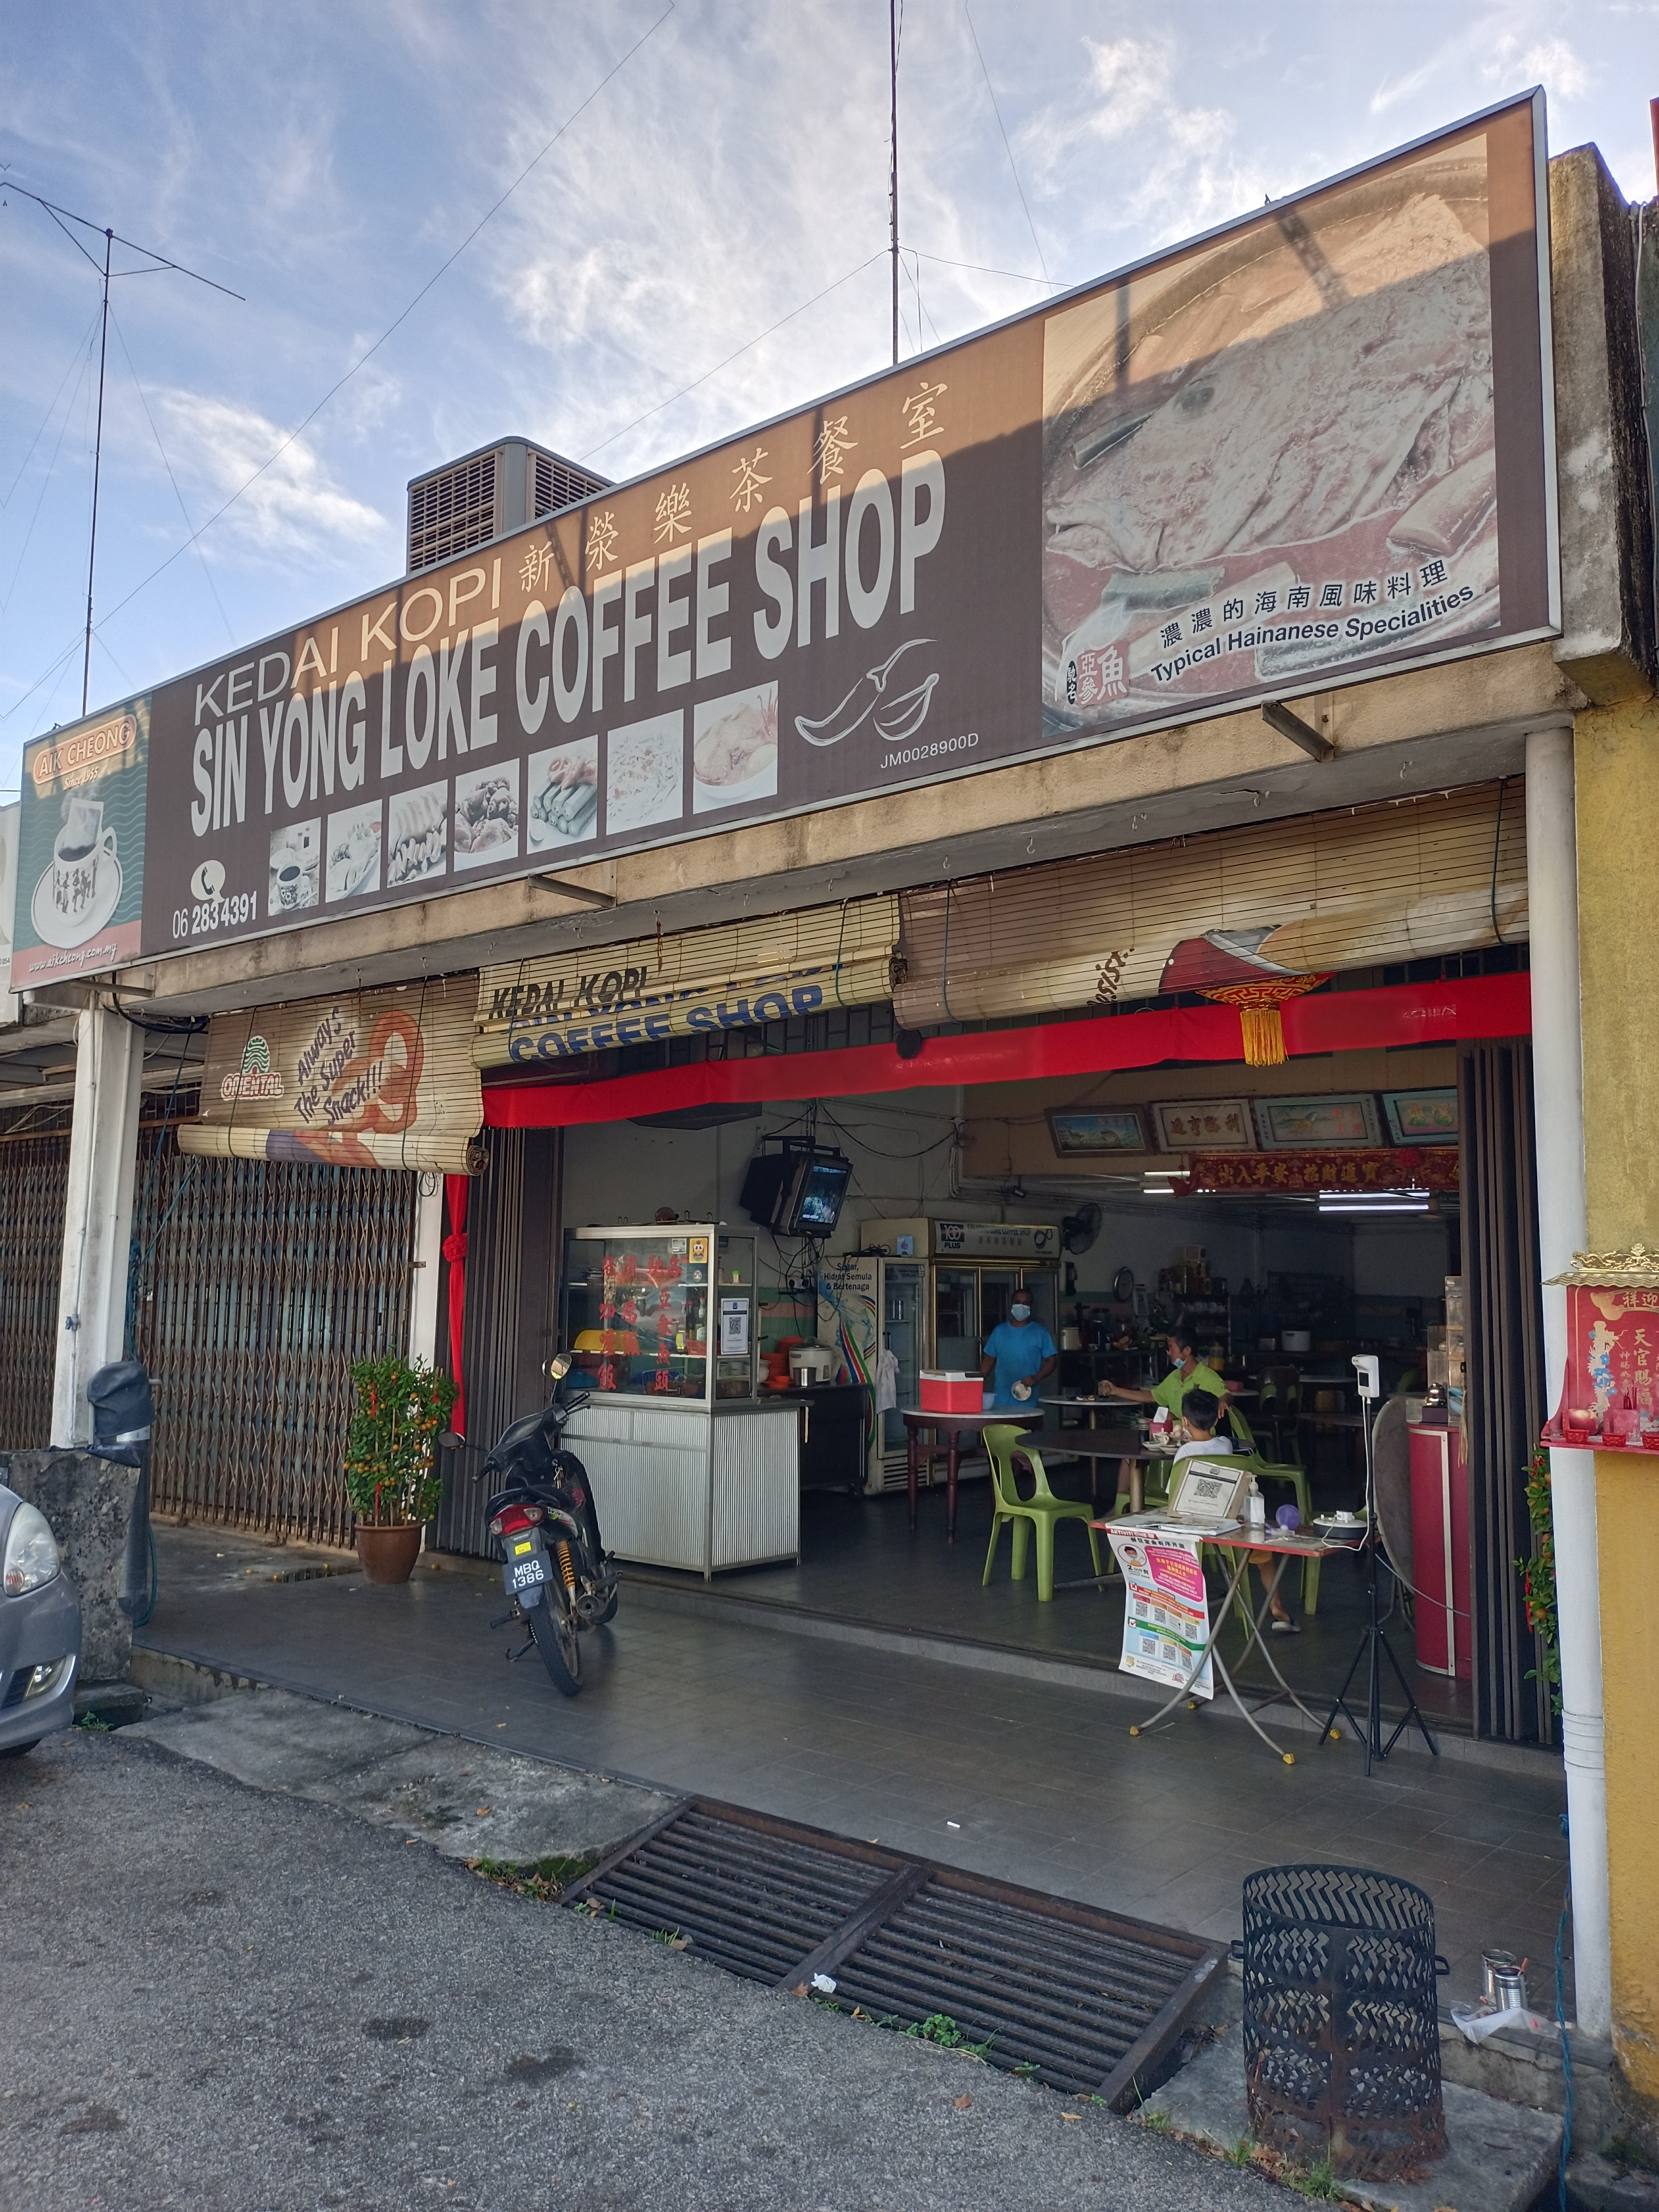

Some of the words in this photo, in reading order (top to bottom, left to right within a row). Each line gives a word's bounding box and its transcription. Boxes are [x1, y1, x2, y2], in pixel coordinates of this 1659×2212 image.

[1160, 559, 1448, 649] 濃濃的海南風味料理
[191, 713, 248, 837] SIN
[259, 670, 366, 815] YONG
[380, 617, 499, 779] LOKE
[516, 527, 733, 734] COFFEE
[753, 449, 946, 660] SHOP
[194, 627, 338, 726] KEDAI
[361, 557, 502, 661] KOPI
[1151, 637, 1220, 681] Typical
[1228, 624, 1339, 651] Hainanese
[1345, 586, 1474, 640] Specialities
[38, 747, 64, 779] AIK
[67, 720, 131, 766] CHEONG
[880, 733, 979, 769] JM0028900D
[63, 778, 81, 791] Since
[173, 908, 188, 939] 06
[29, 943, 118, 973] www.aikcheong.com.my
[574, 966, 648, 1007] KOPI
[686, 985, 823, 1034] SHOP
[298, 1006, 341, 1085] Always
[294, 1085, 320, 1124] The
[320, 1030, 356, 1091] Super
[512, 1569, 544, 1589] 1386
[514, 1560, 540, 1578] MBQ
